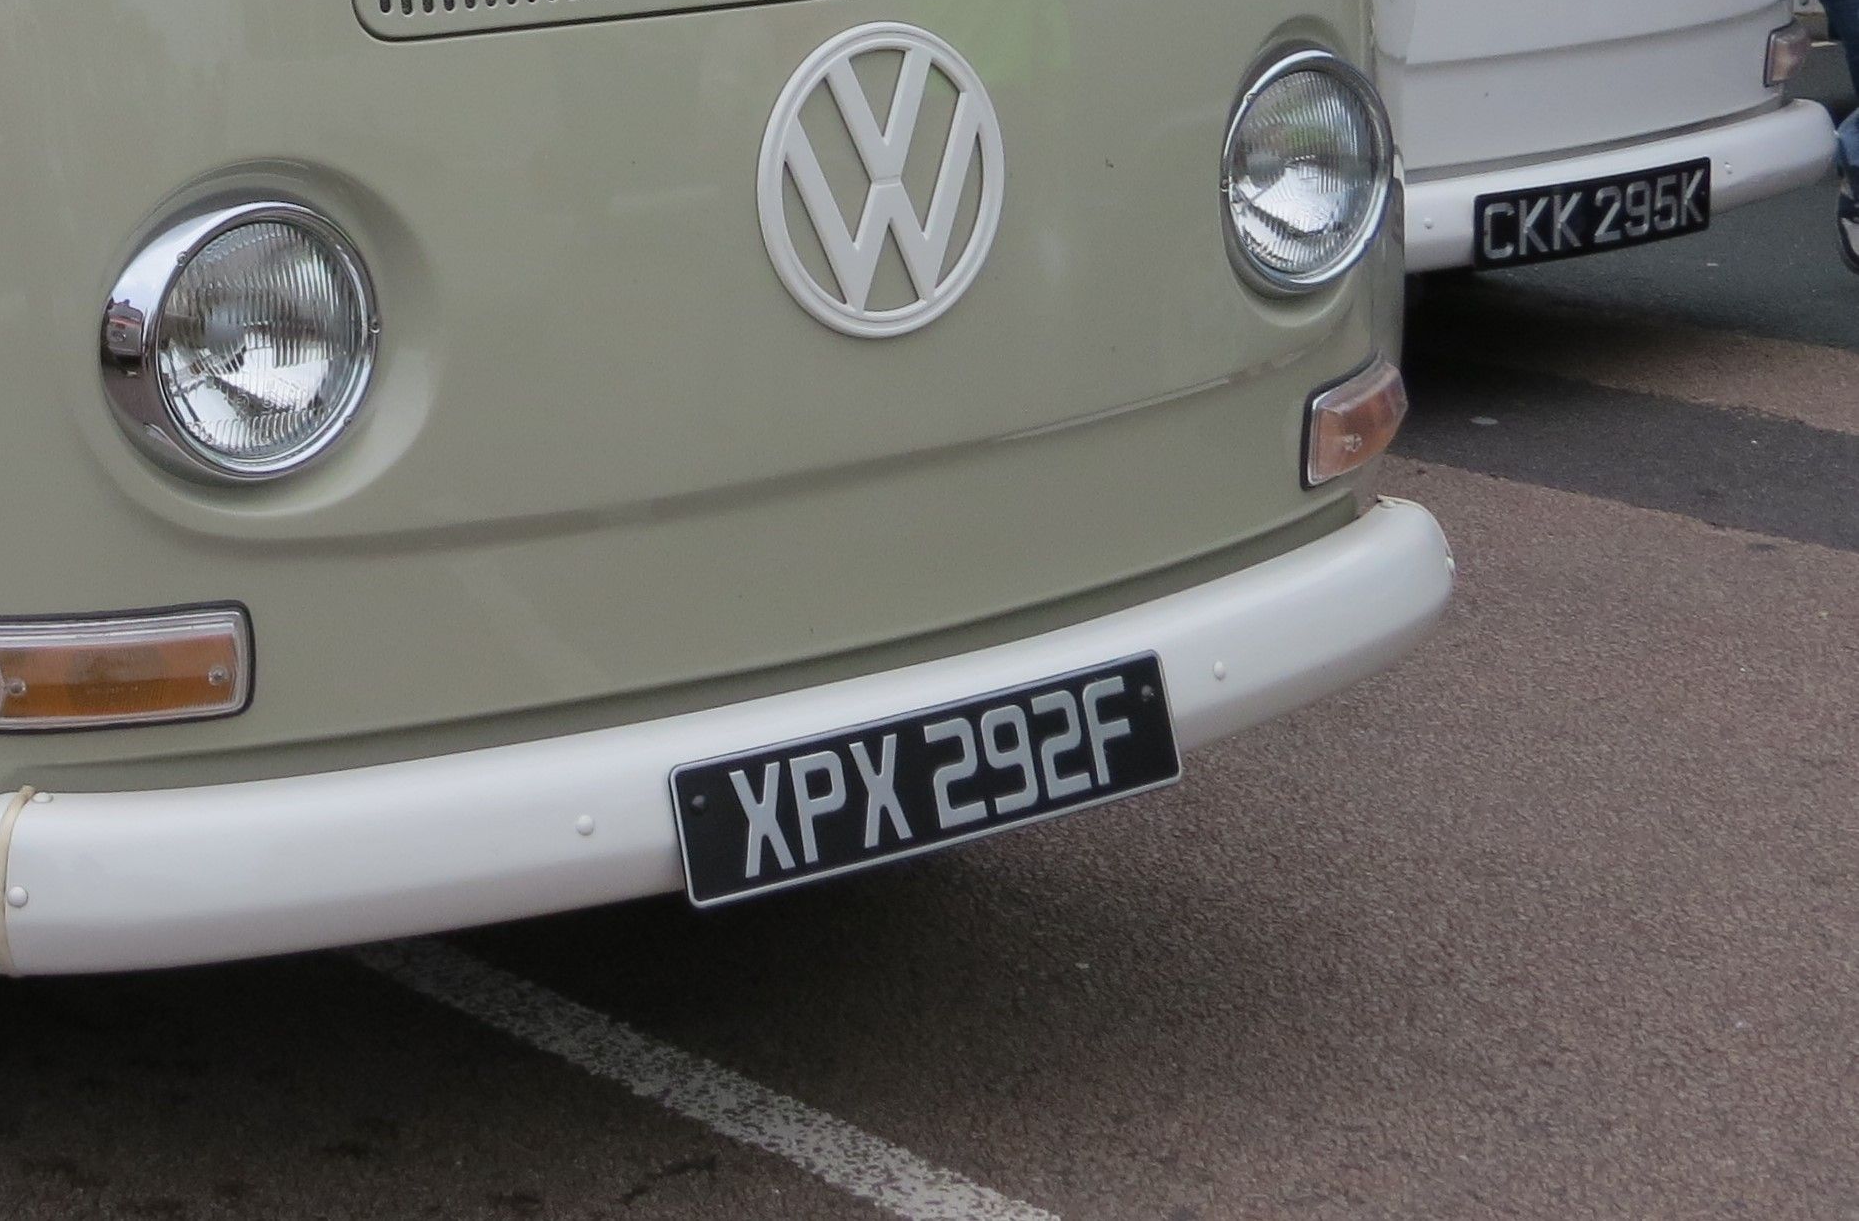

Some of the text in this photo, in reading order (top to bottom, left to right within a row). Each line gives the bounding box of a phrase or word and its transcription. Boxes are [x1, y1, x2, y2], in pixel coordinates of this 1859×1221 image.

[1483, 168, 1706, 260] CKK 295K
[729, 675, 1132, 879] XPX 292F
